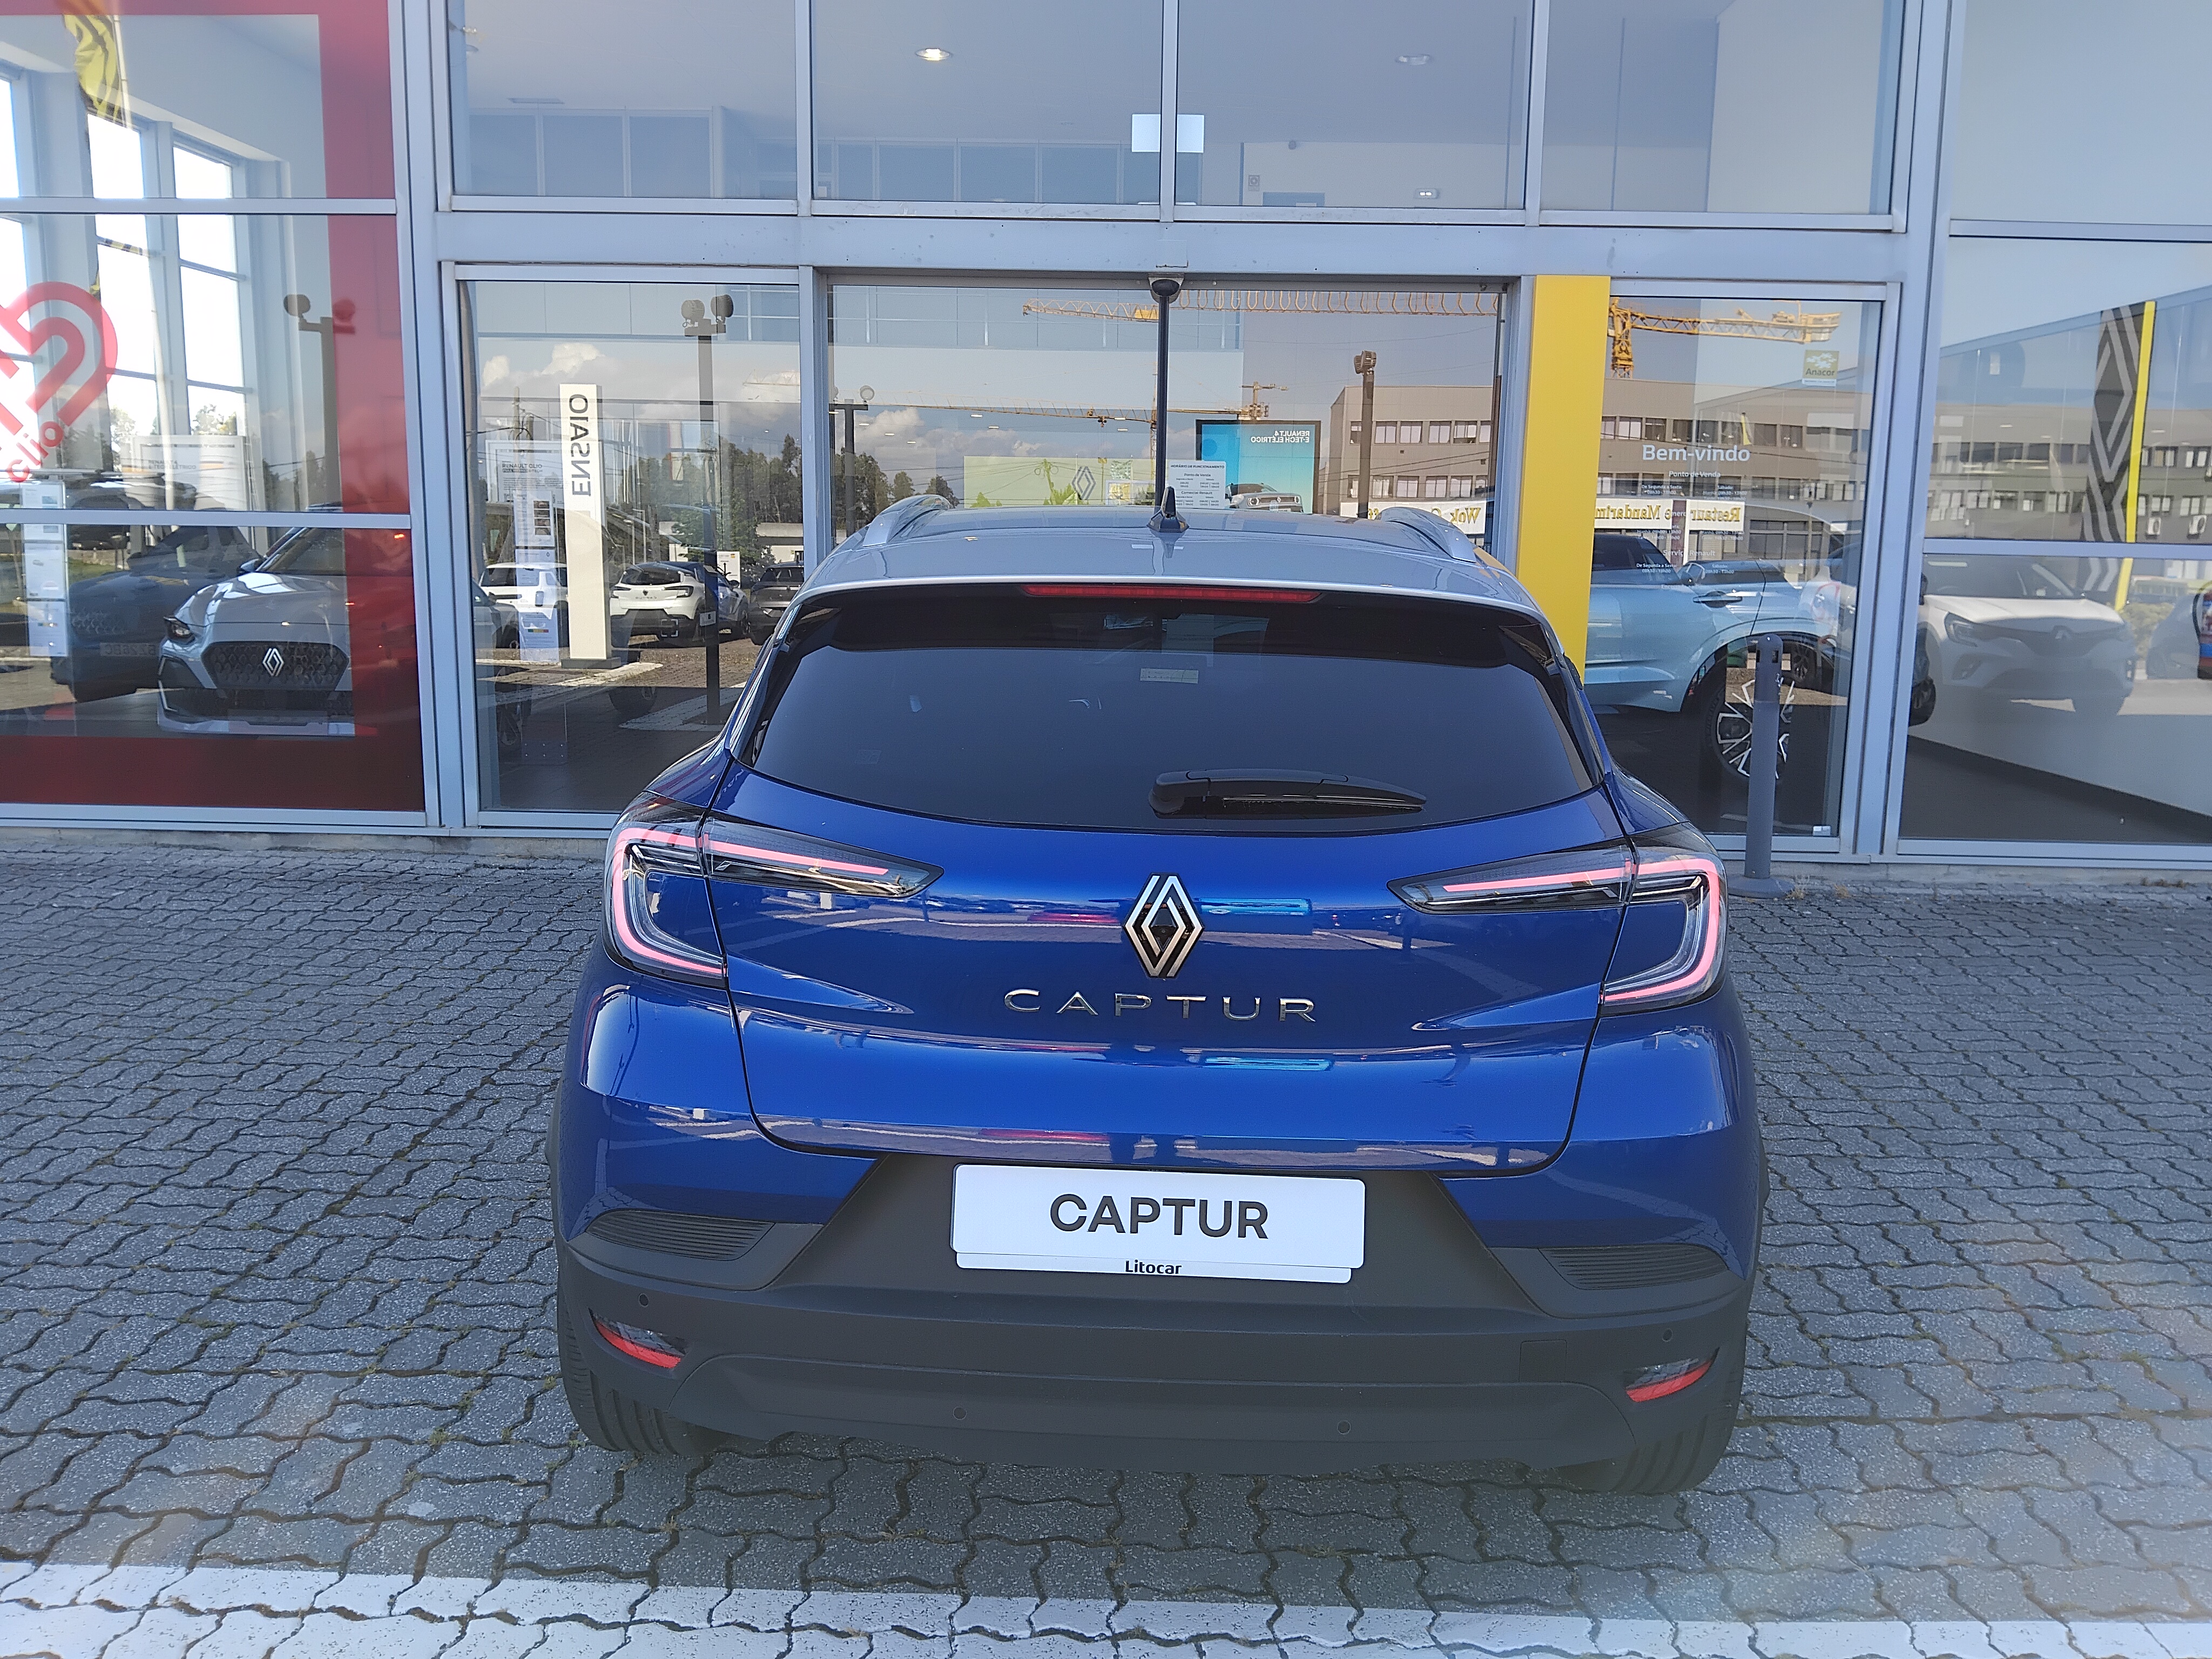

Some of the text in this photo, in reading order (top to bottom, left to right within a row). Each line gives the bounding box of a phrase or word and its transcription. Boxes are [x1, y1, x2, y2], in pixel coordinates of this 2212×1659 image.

[1805, 368, 1835, 376] Anacor
[1642, 444, 1750, 461] Bem-vindo
[1003, 989, 1316, 1022] CAPTUR
[1050, 1193, 1269, 1239] CAPTUR
[1125, 1259, 1182, 1276] Litocar
